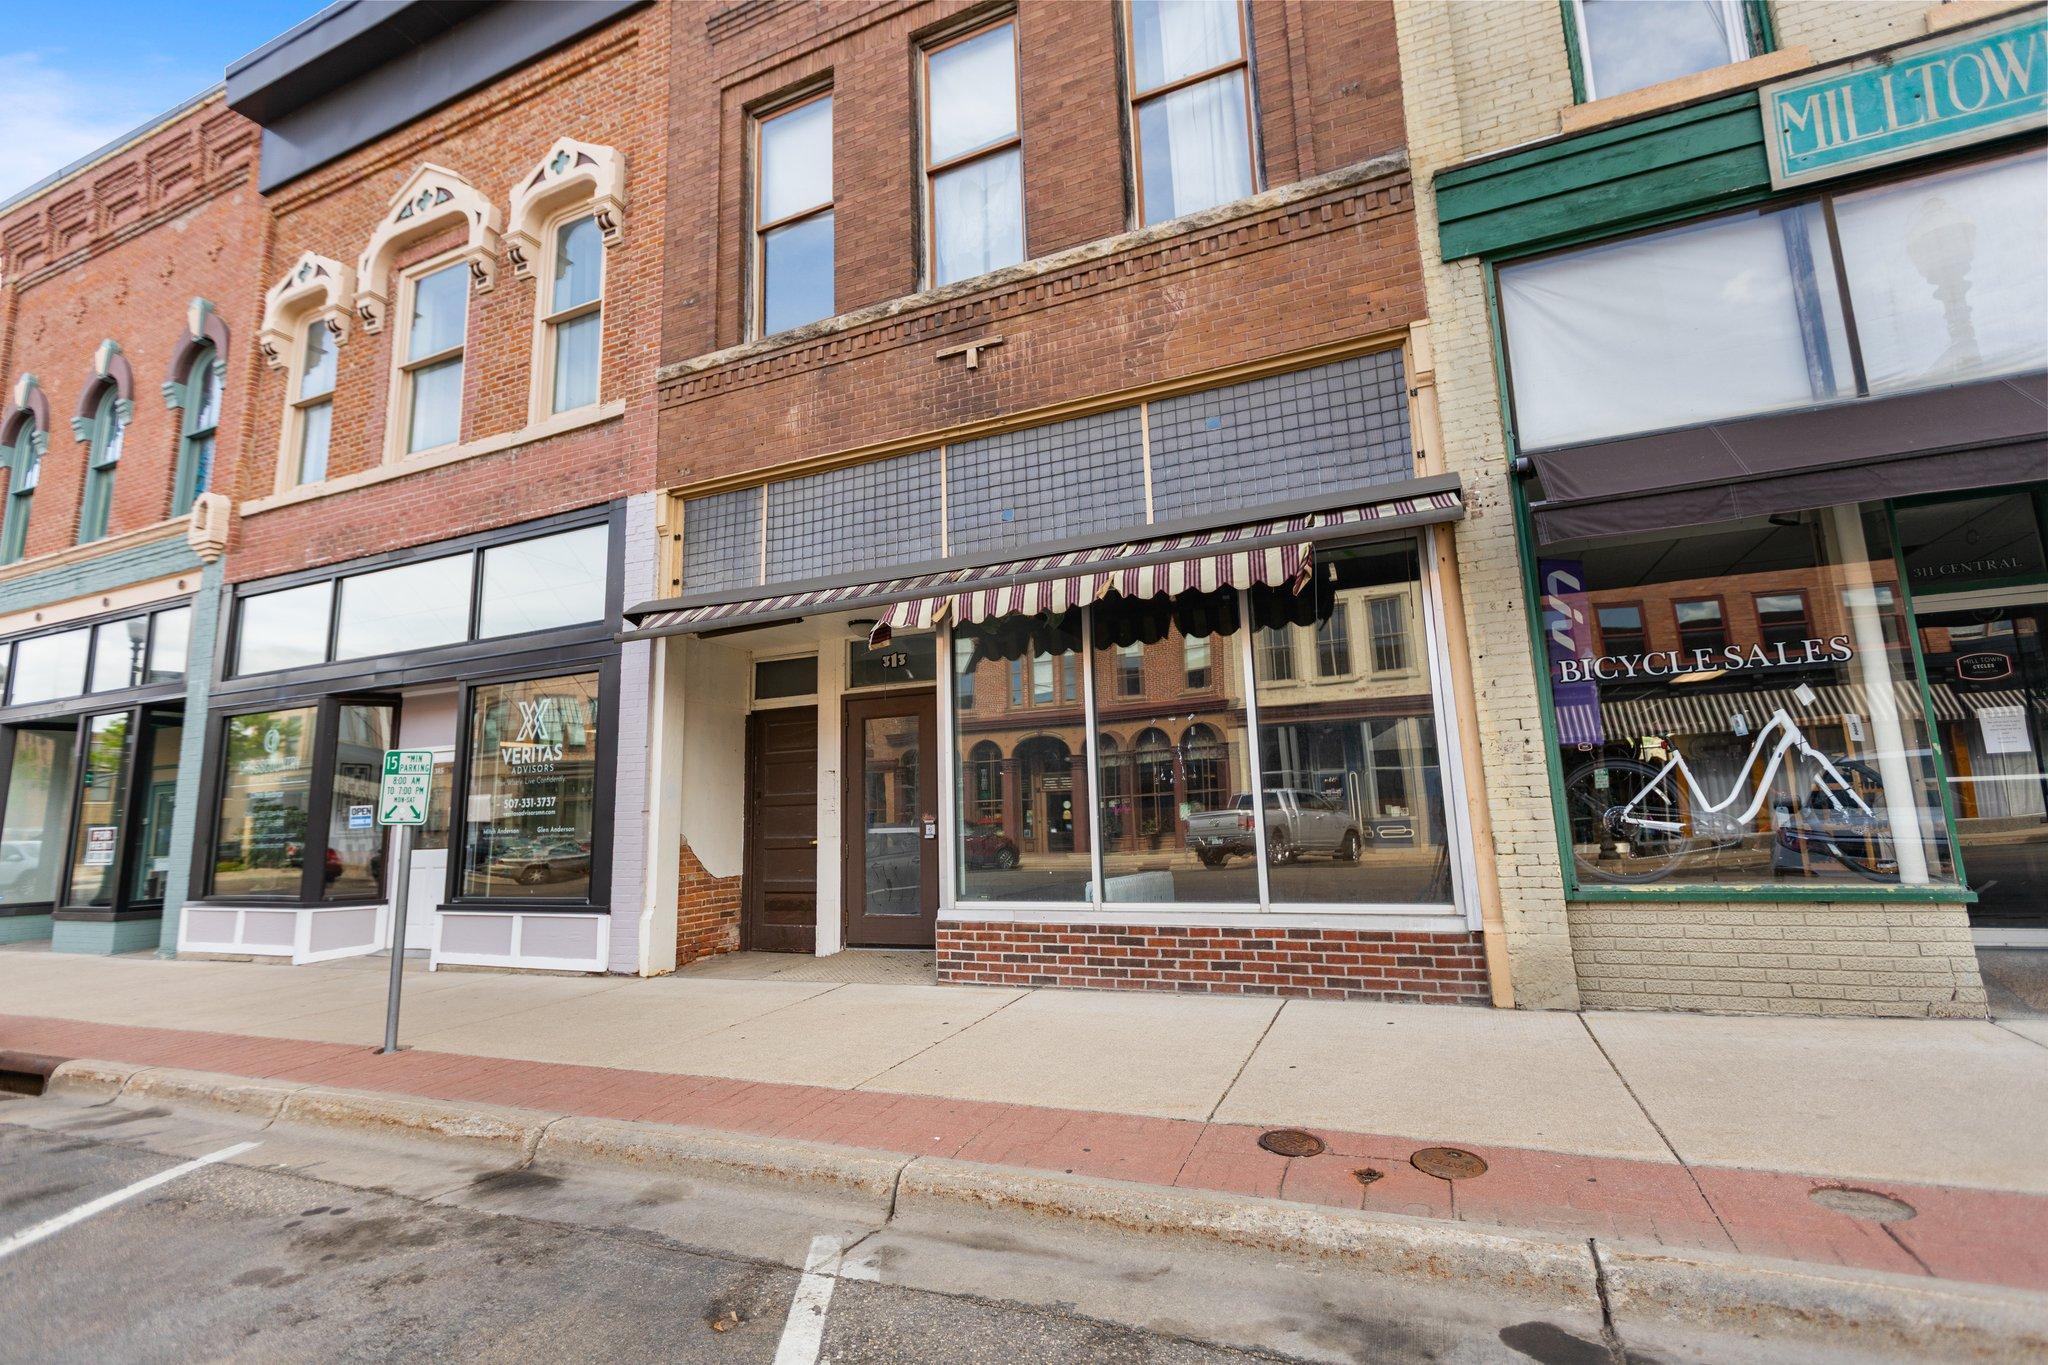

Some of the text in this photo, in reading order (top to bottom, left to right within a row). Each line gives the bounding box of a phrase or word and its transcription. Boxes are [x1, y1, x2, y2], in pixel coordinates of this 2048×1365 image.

[1780, 33, 2048, 157] MILLTOW
[1913, 557, 2023, 577] 311 CENTRAL
[882, 652, 907, 668] 313
[1723, 636, 1854, 671] SALES
[501, 743, 563, 766] VERITAS
[386, 756, 398, 770] 15
[400, 764, 430, 772] PARKING
[511, 764, 554, 774] ADVISORS
[393, 777, 421, 785] 8:00 AM
[387, 786, 424, 795] TO 7:00 PM
[503, 796, 557, 809] 507-331-3737
[351, 807, 372, 816] OPEN
